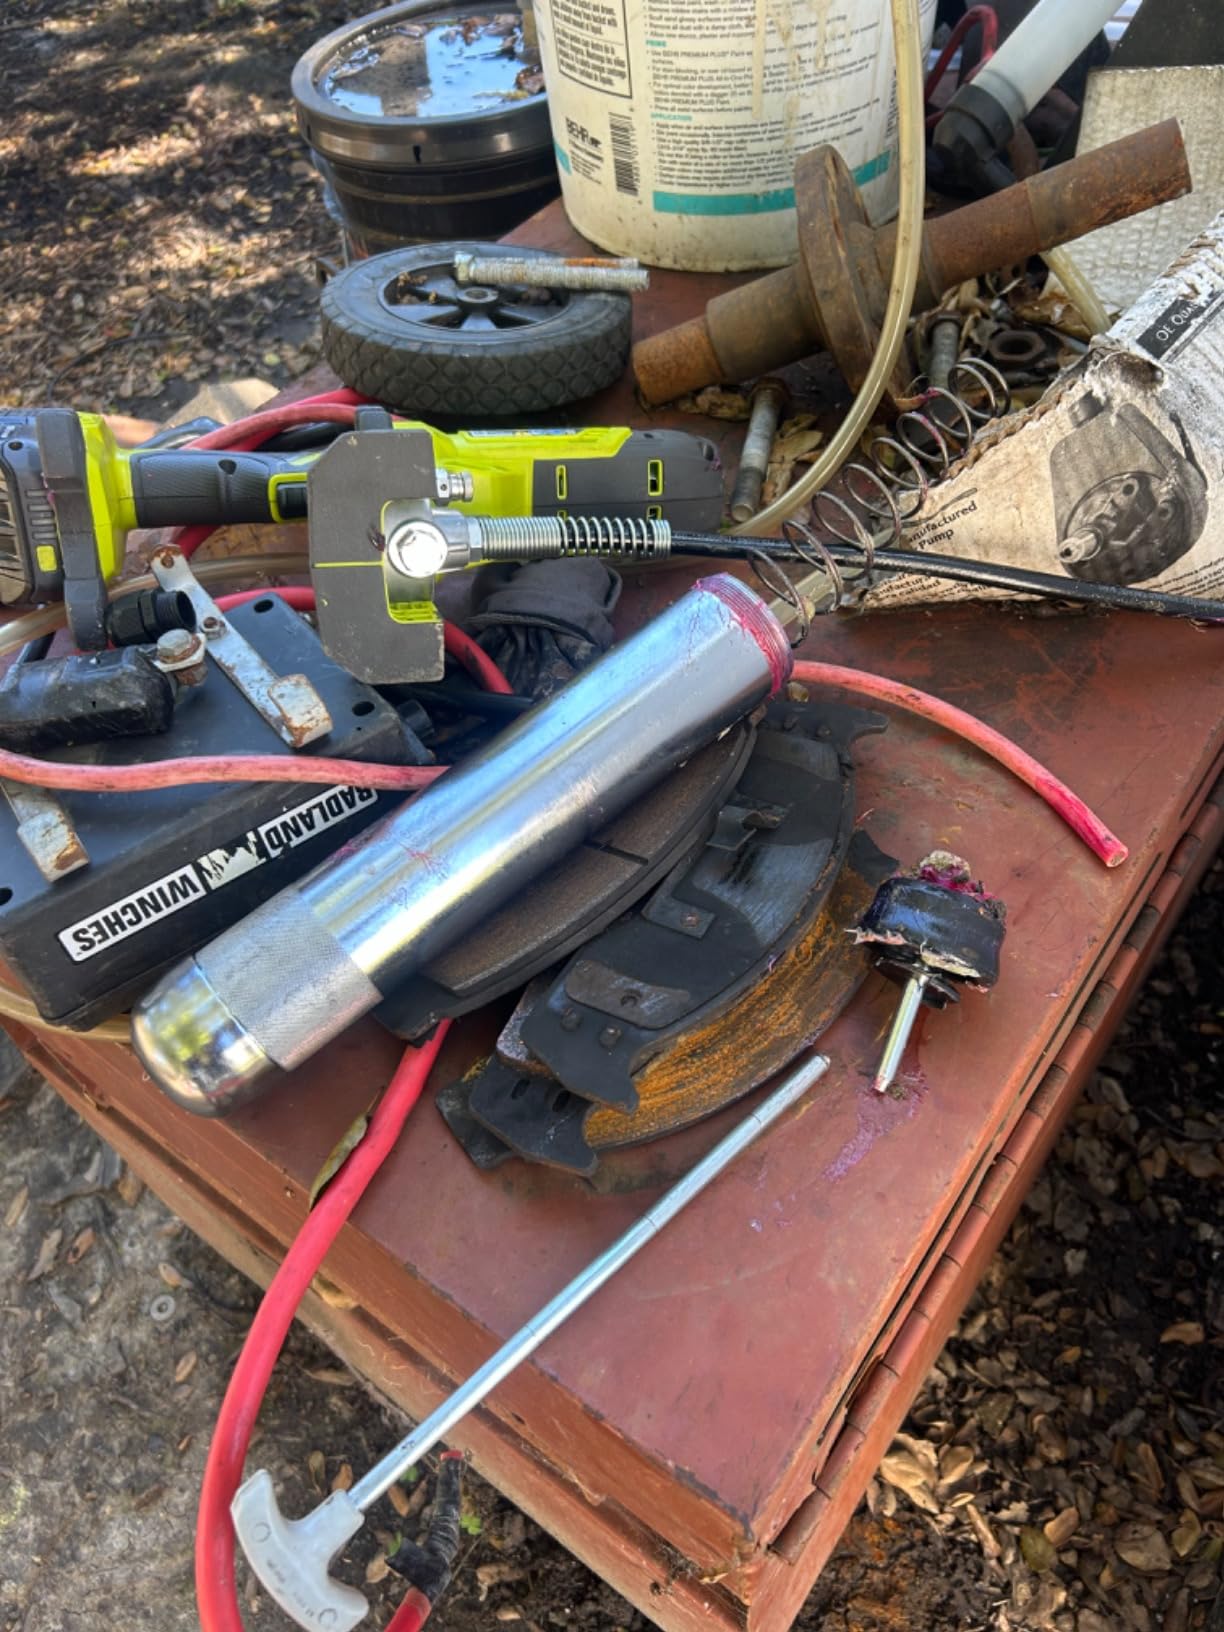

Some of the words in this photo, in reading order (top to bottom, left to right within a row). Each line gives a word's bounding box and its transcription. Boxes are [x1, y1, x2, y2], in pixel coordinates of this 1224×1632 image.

[1156, 324, 1176, 341] OE
[909, 500, 978, 543] nufactured
[918, 528, 955, 549] Pump
[264, 785, 374, 851] BADLAND
[71, 873, 200, 953] WINCHES
